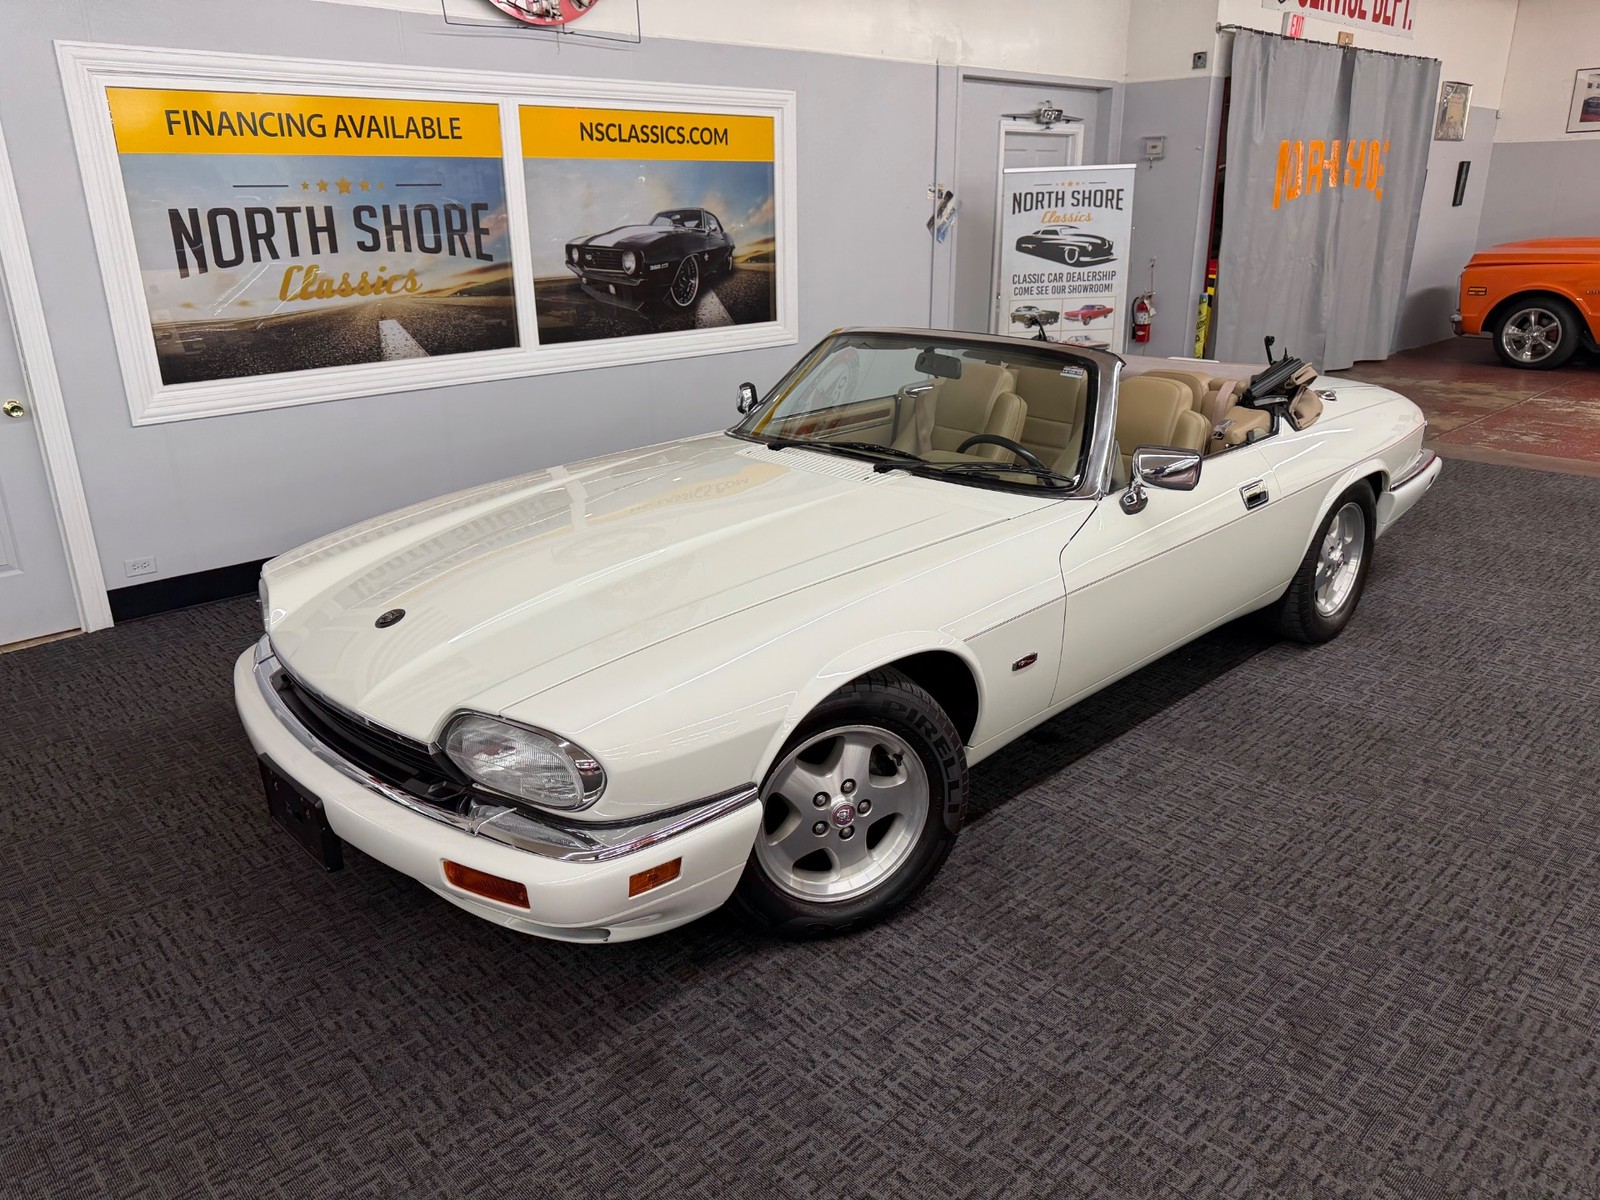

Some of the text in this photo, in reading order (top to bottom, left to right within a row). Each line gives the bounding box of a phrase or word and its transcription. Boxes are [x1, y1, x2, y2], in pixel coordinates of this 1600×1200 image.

[164, 109, 463, 140] FINANCING AVAILABLE
[579, 121, 729, 146] NSCLASSICS.COM
[1012, 188, 1124, 215] NORTH SHORE
[1040, 210, 1093, 224] Classics
[167, 202, 494, 279] NORTH SHORE
[278, 264, 423, 302] Classics
[1012, 270, 1117, 285] CLASSIC CAR DEALERSHIP
[1013, 283, 1113, 296] COME SEE OUR SHOWROOM!
[881, 698, 960, 814] PIRELLI
